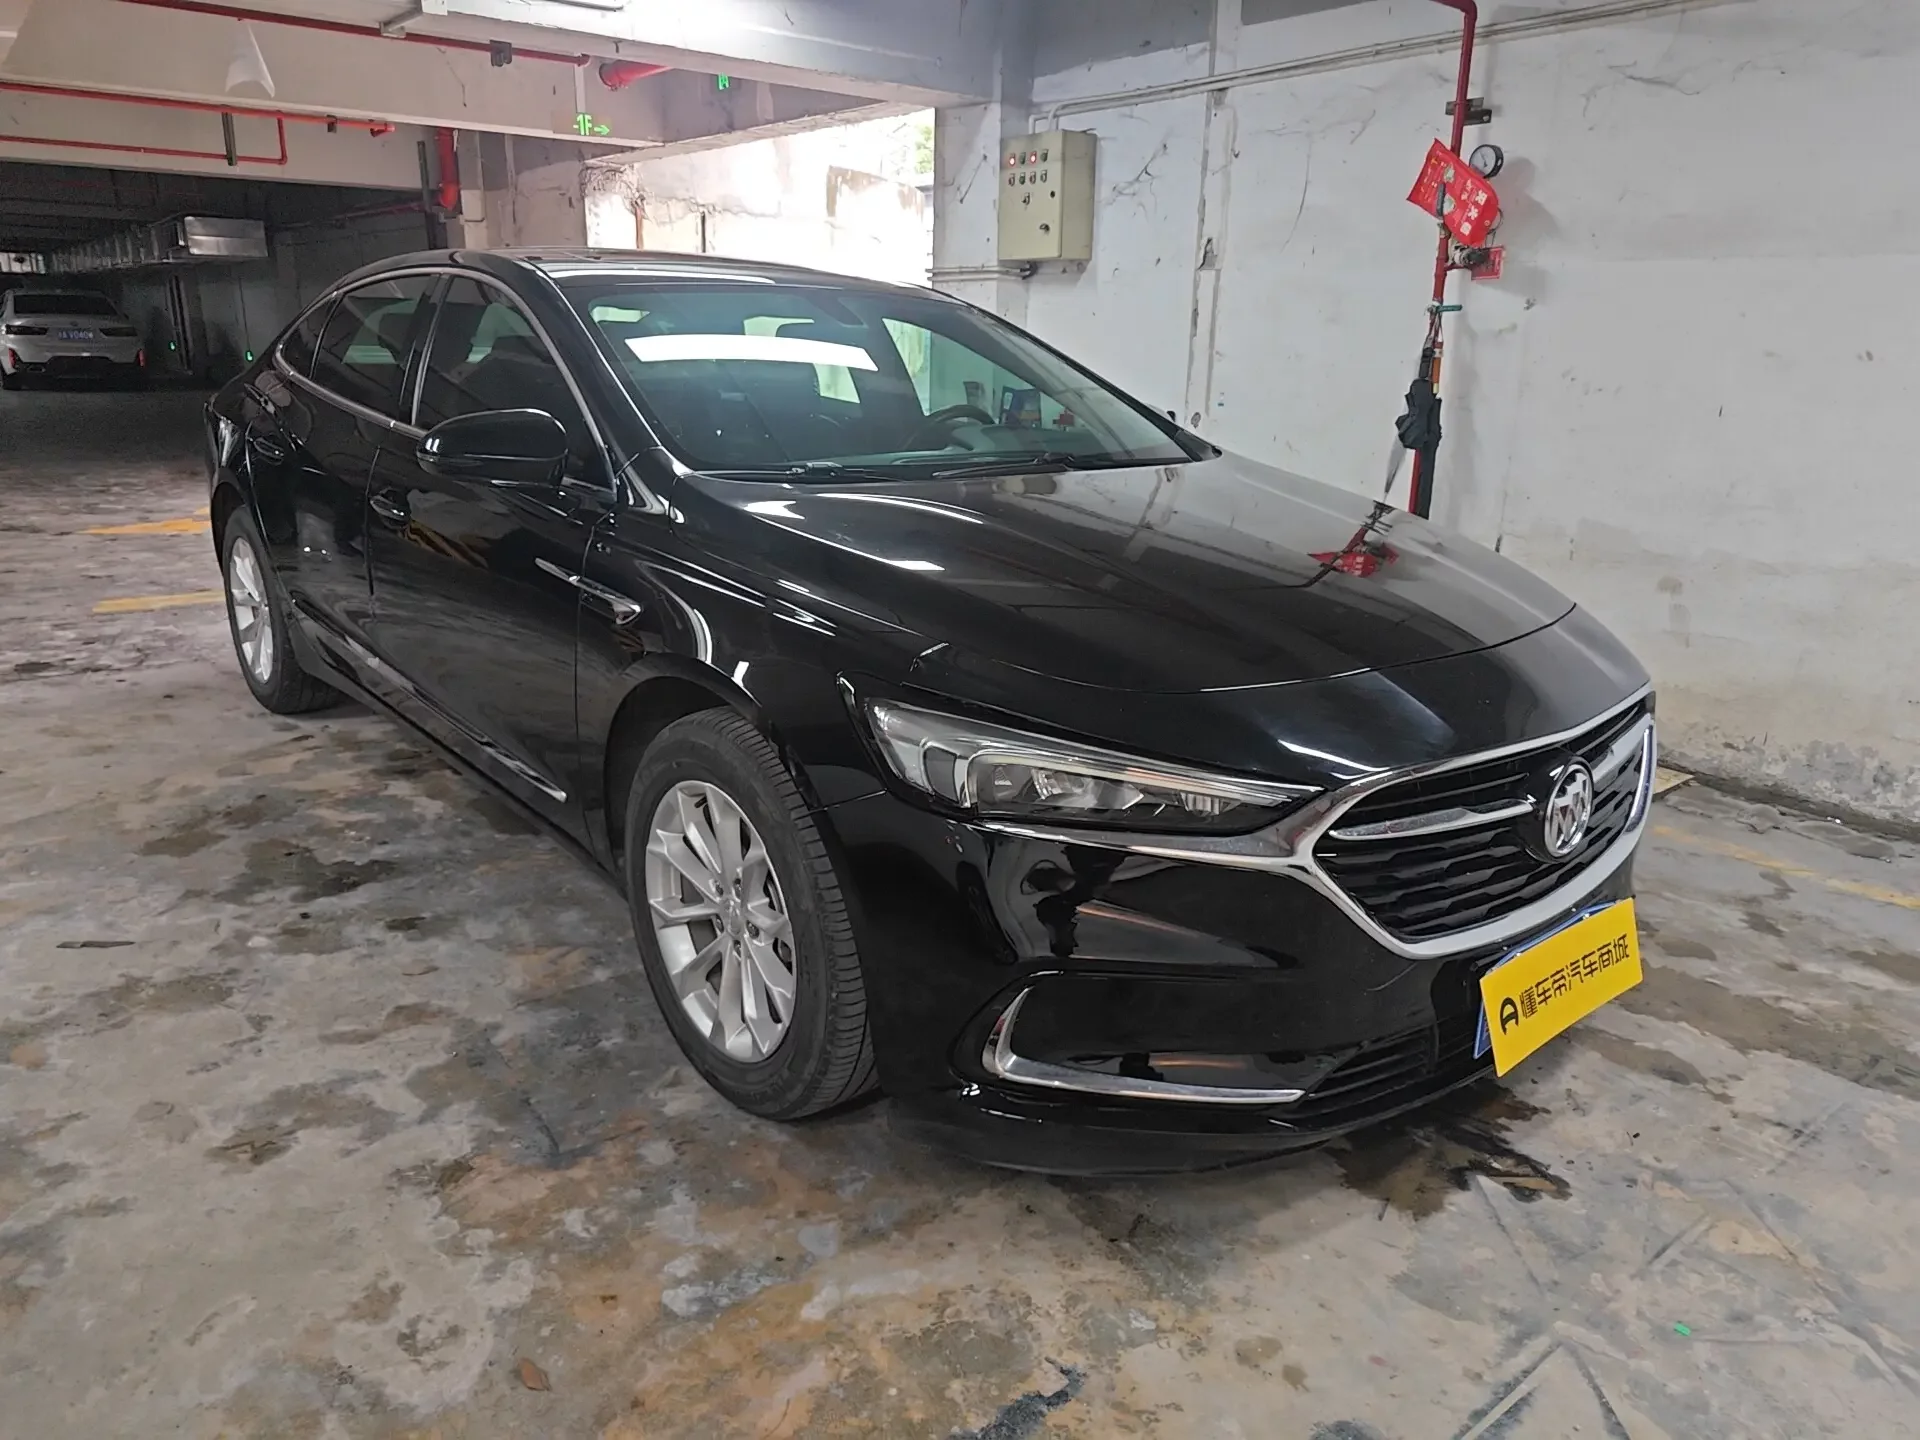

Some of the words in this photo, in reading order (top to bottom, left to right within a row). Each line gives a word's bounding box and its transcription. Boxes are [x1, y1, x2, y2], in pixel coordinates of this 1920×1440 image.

[573, 113, 592, 136] -1F
[1518, 933, 1631, 1020] 懂车帝汽车商城
